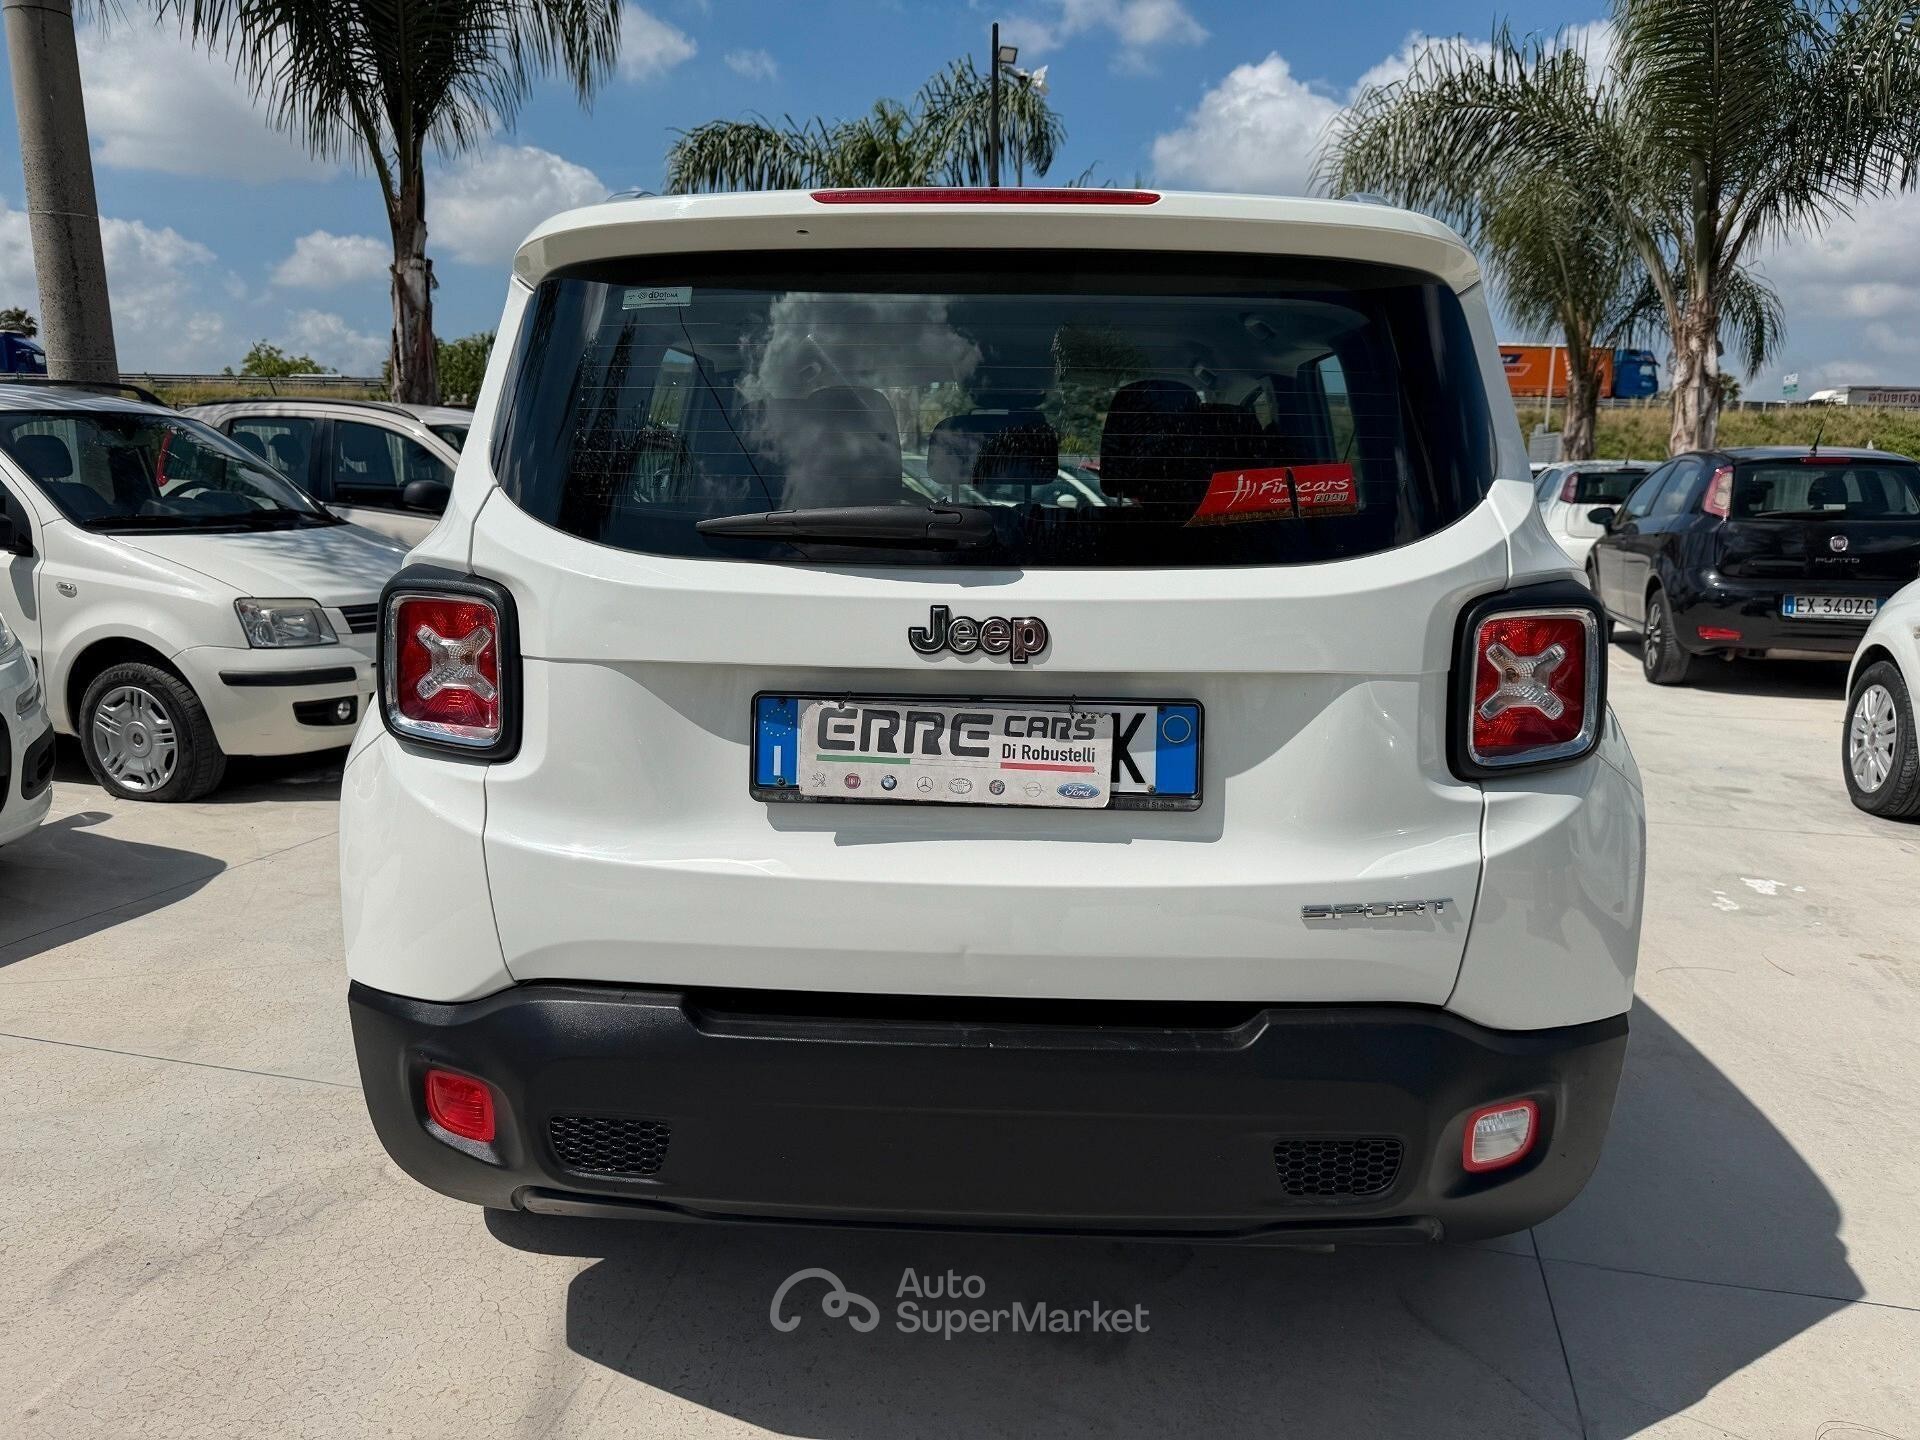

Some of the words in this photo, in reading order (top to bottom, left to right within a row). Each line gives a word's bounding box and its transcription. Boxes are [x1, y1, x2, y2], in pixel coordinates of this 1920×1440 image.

[1796, 598, 1815, 613] EX
[1823, 598, 1874, 614] 340ZC
[908, 605, 1048, 664] Jeep
[818, 707, 993, 757] ERRE
[1004, 716, 1097, 741] CARS
[1111, 713, 1146, 783] K
[1002, 743, 1016, 759] Di
[1021, 744, 1095, 763] Robustelli
[1301, 898, 1454, 919] SPORT
